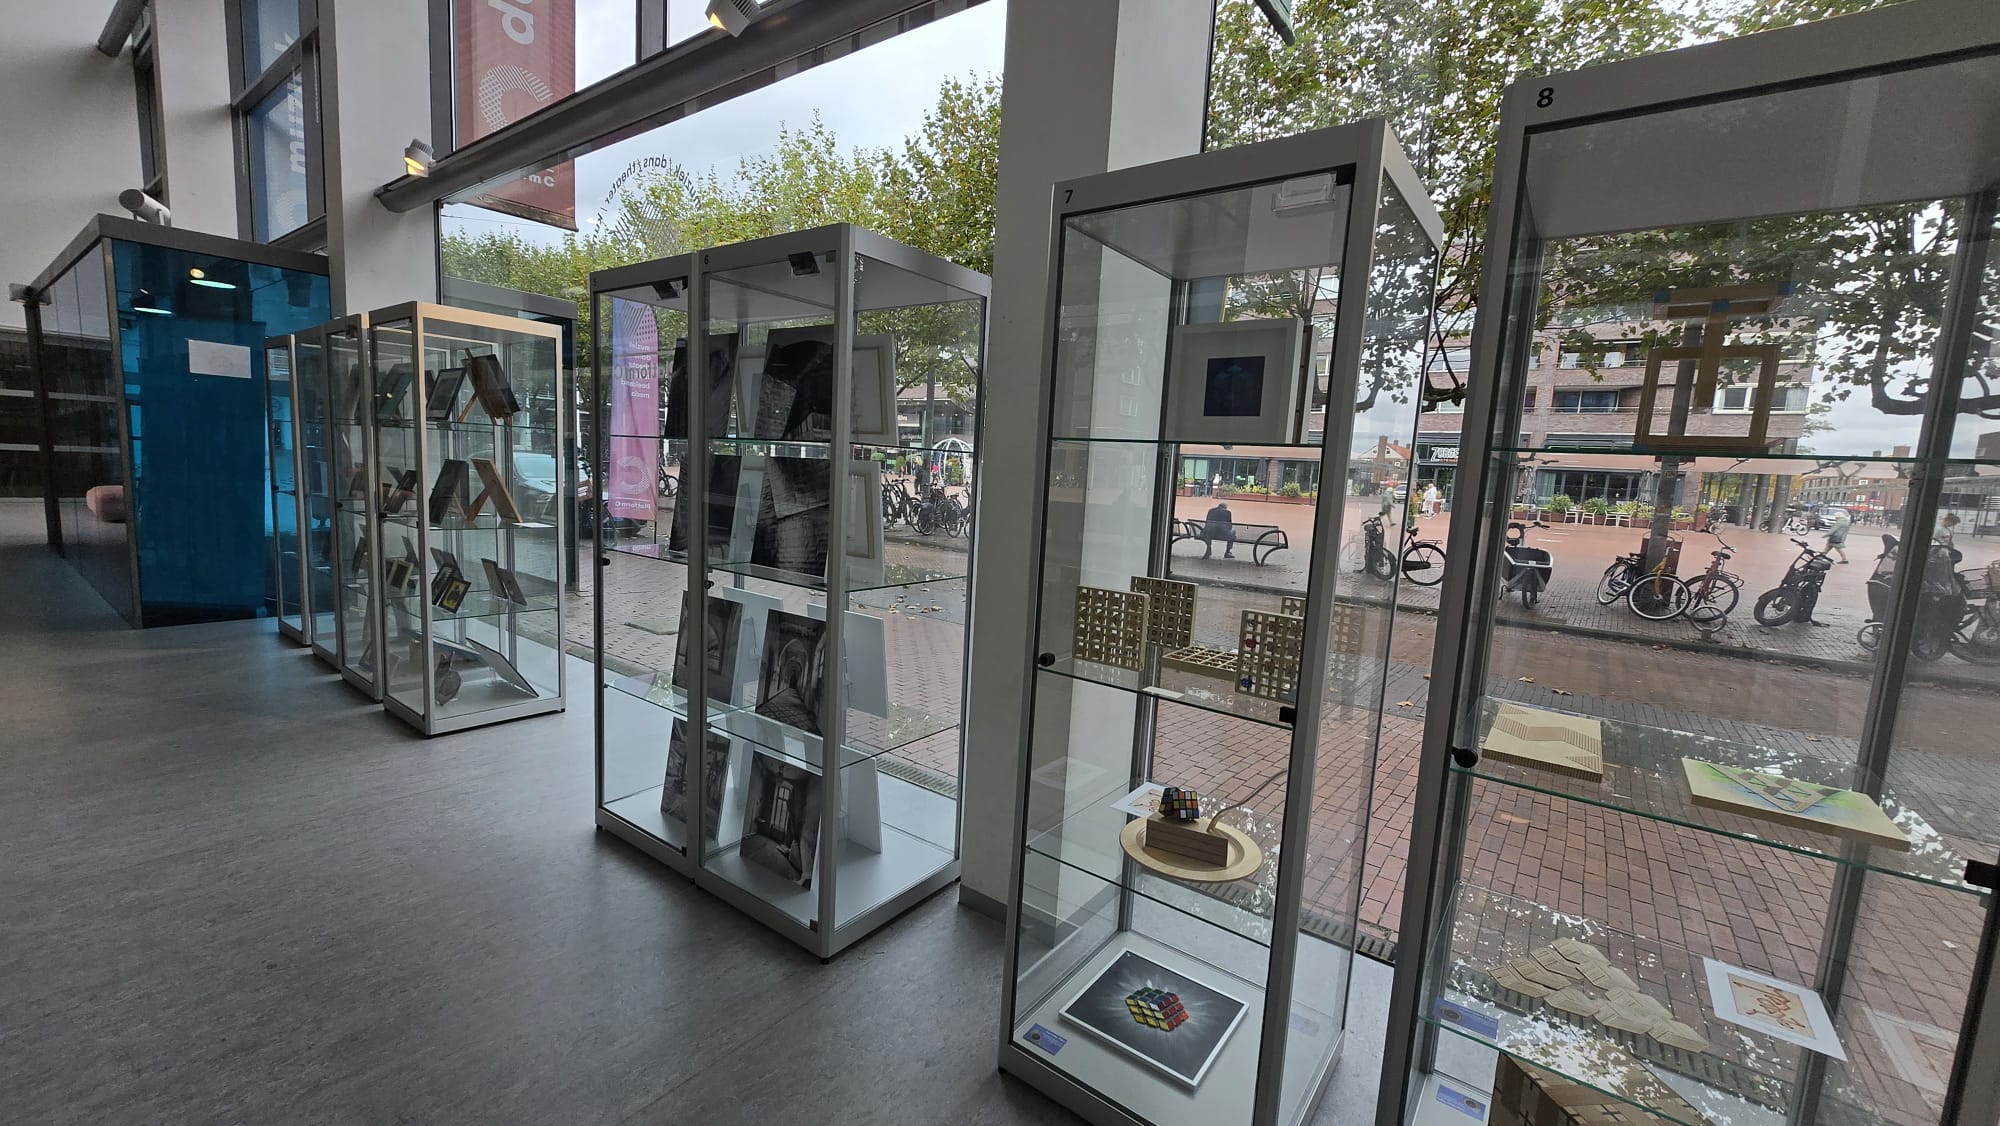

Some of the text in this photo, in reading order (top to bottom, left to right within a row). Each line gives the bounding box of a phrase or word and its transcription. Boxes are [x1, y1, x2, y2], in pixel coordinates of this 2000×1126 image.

[1536, 87, 1554, 108] 8
[1065, 189, 1073, 204] 7
[704, 254, 709, 265] 6
